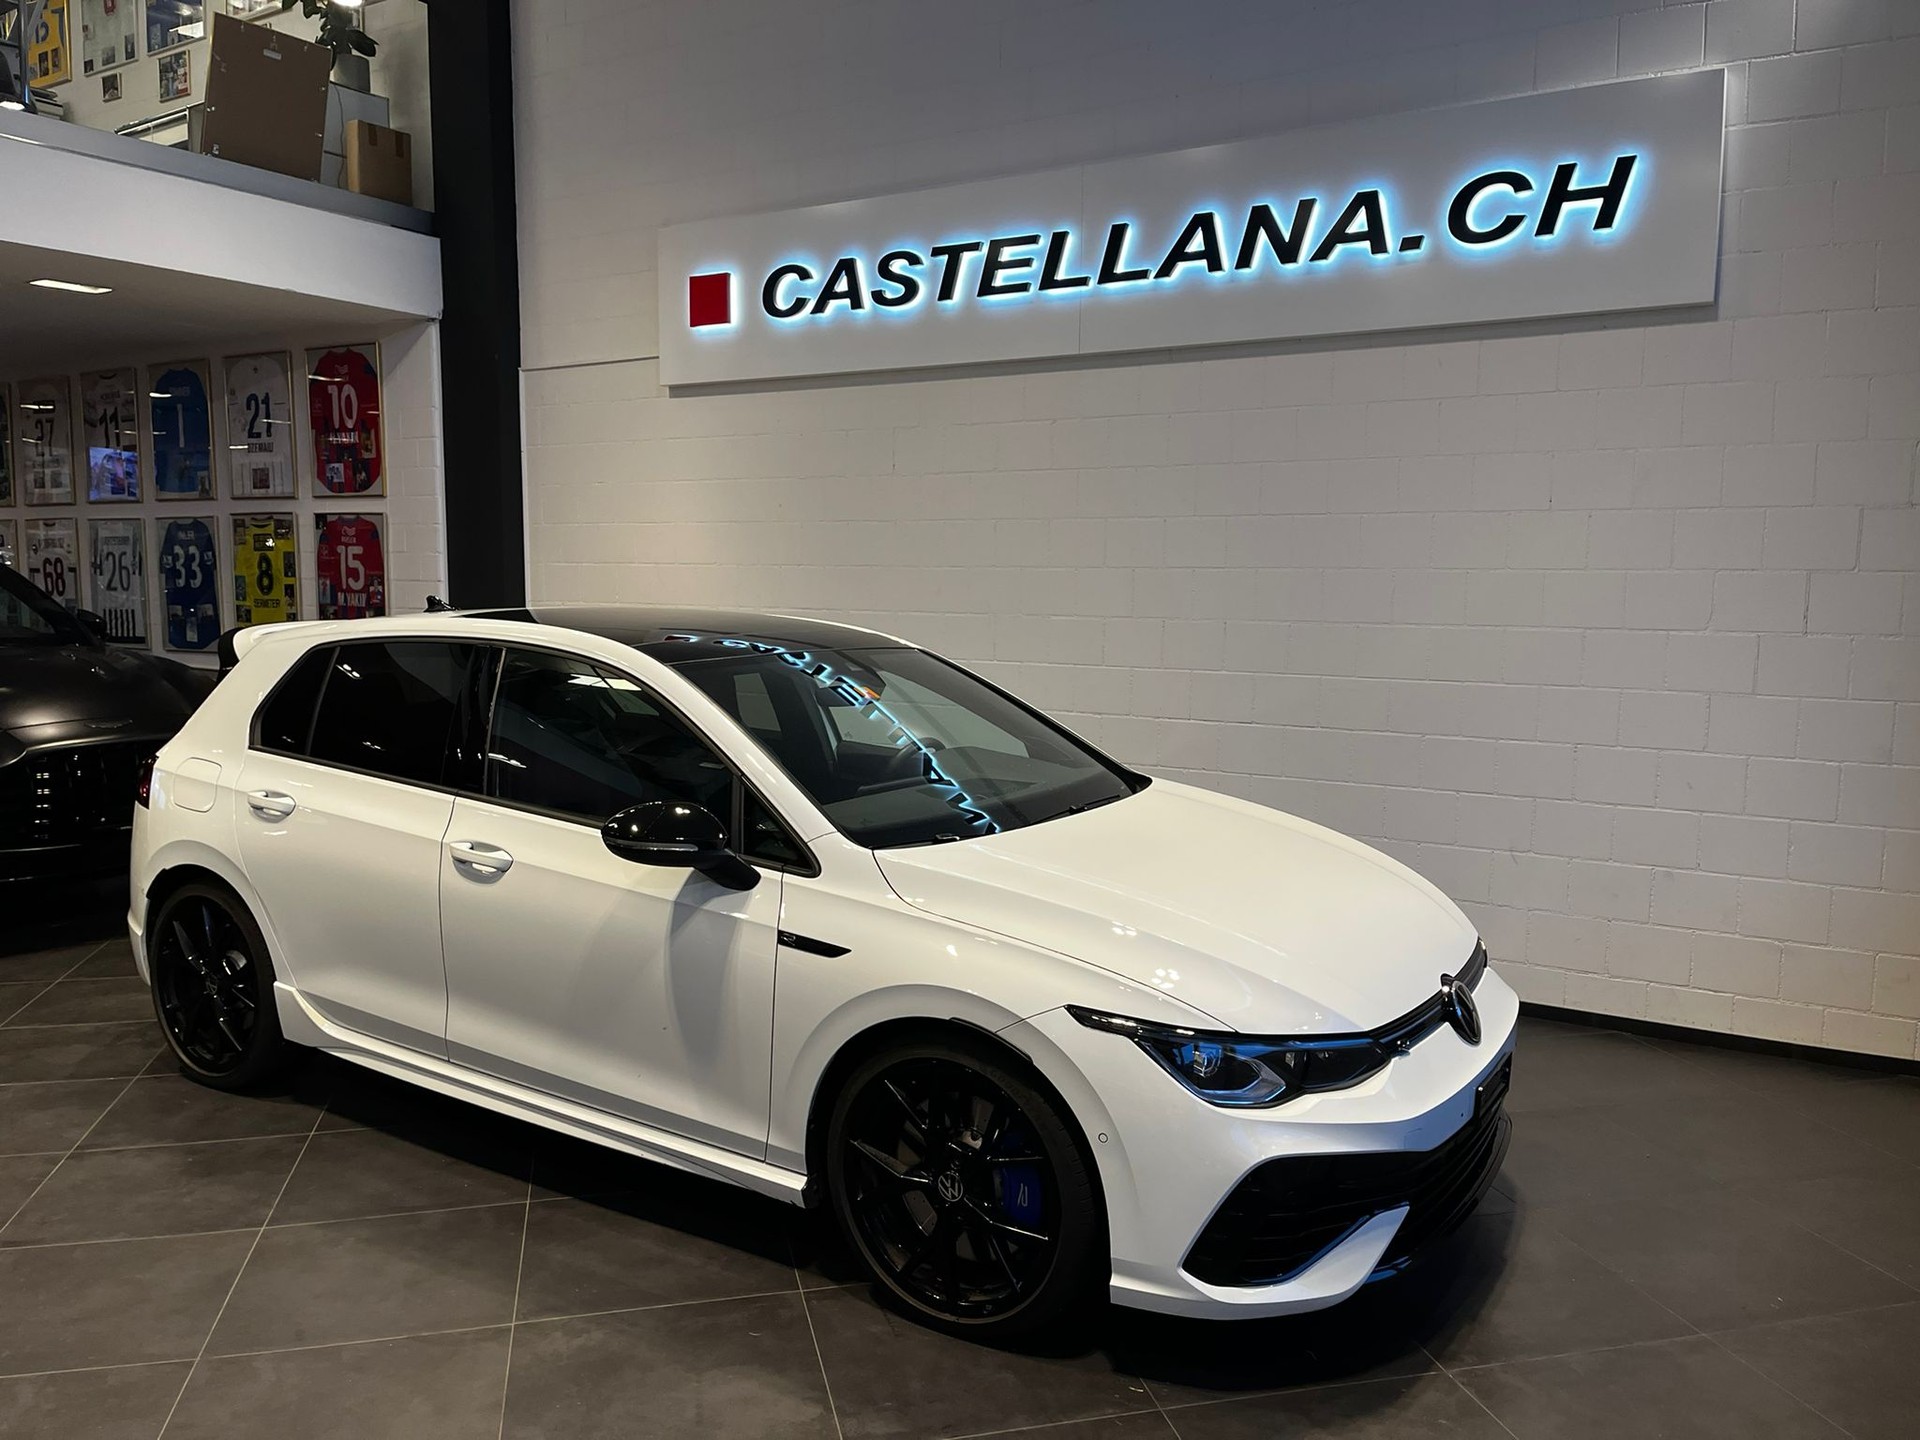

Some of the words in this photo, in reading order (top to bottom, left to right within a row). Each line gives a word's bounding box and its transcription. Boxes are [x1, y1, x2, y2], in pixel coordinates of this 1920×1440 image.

[762, 153, 1637, 320] CASTELLANA.CH
[99, 406, 120, 449] 11
[246, 392, 272, 439] 21
[327, 383, 358, 430] 10
[43, 557, 66, 598] 68
[105, 551, 130, 592] 26
[173, 545, 202, 589] 33
[256, 552, 274, 597] 8
[336, 544, 366, 591] 15
